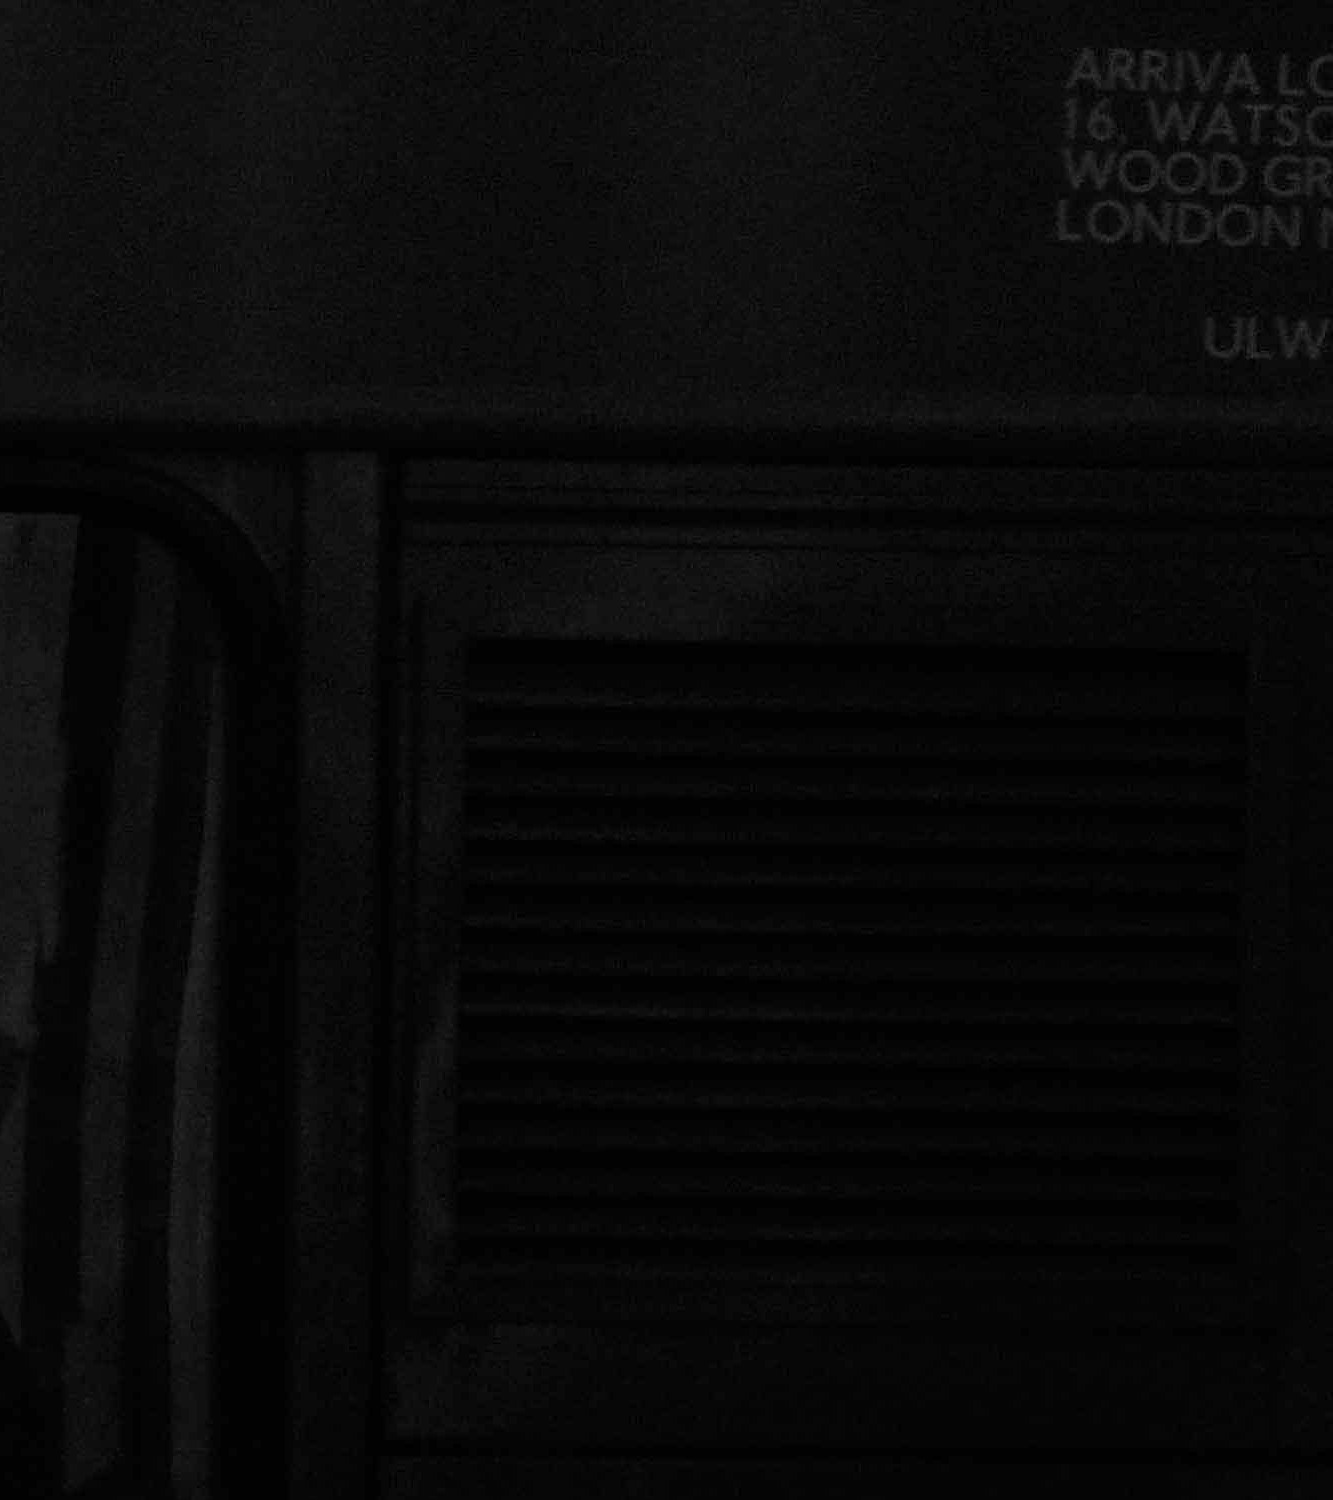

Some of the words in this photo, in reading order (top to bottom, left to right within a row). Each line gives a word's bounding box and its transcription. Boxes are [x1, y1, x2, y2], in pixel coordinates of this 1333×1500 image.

[1064, 47, 1261, 95] ARRIVA
[1062, 149, 1248, 195] WOOD
[1054, 198, 1302, 248] LONDON
[1203, 315, 1331, 360] ULW
